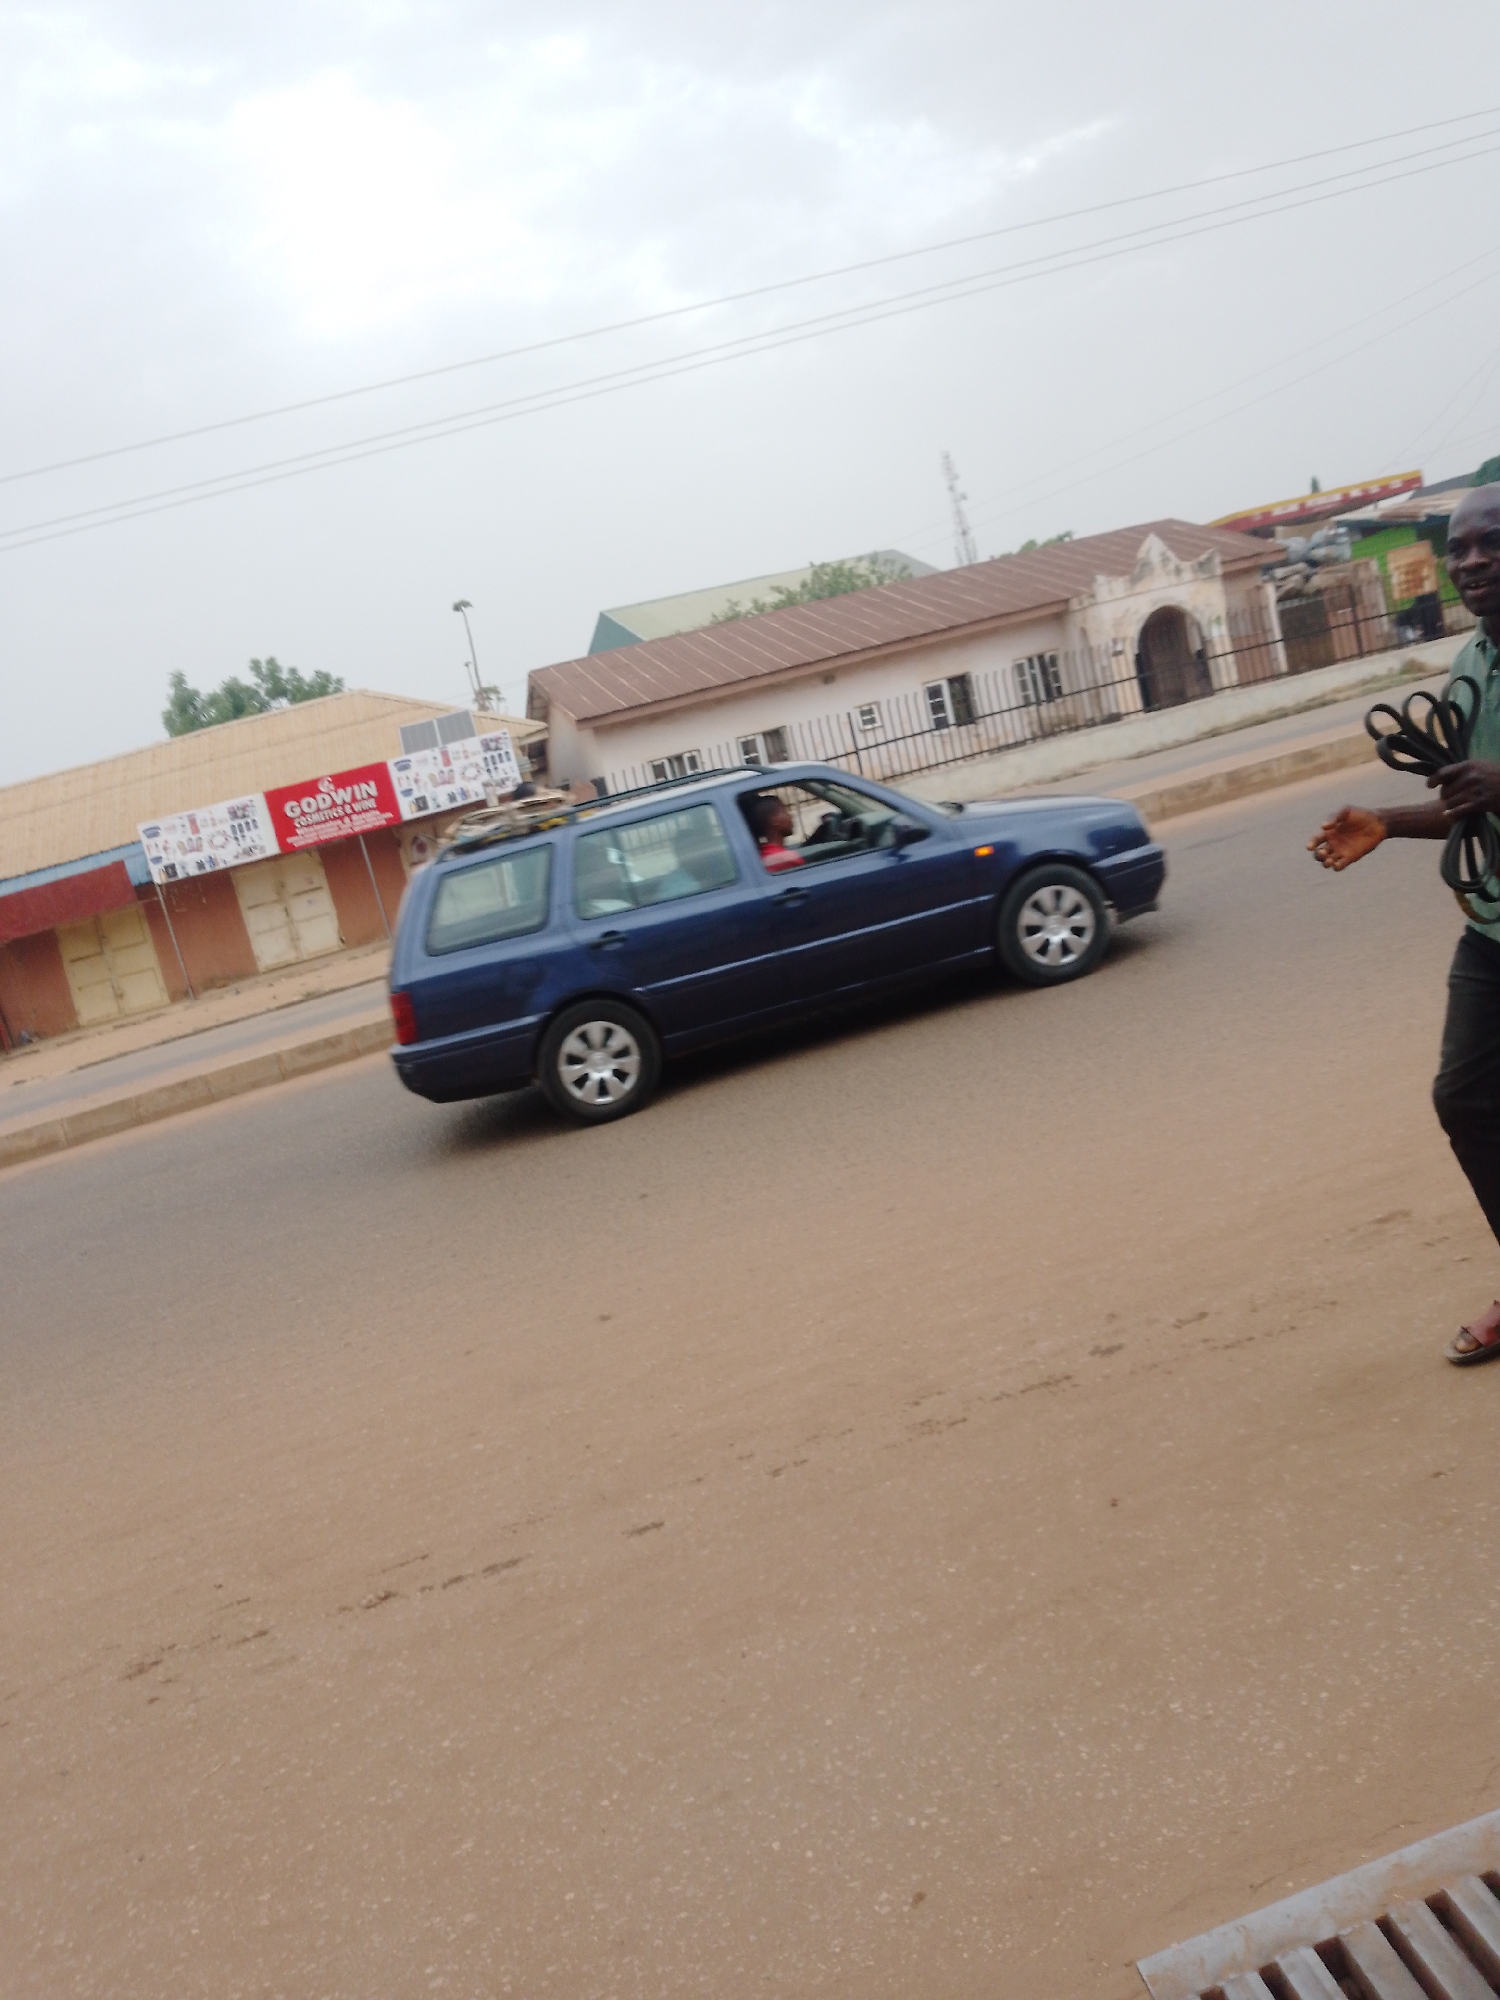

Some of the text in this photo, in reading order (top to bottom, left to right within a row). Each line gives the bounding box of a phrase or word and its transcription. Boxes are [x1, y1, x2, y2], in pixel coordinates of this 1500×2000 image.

[284, 780, 378, 818] GODWIN
[294, 806, 344, 828] COSMETICS
[352, 798, 377, 812] WINE
